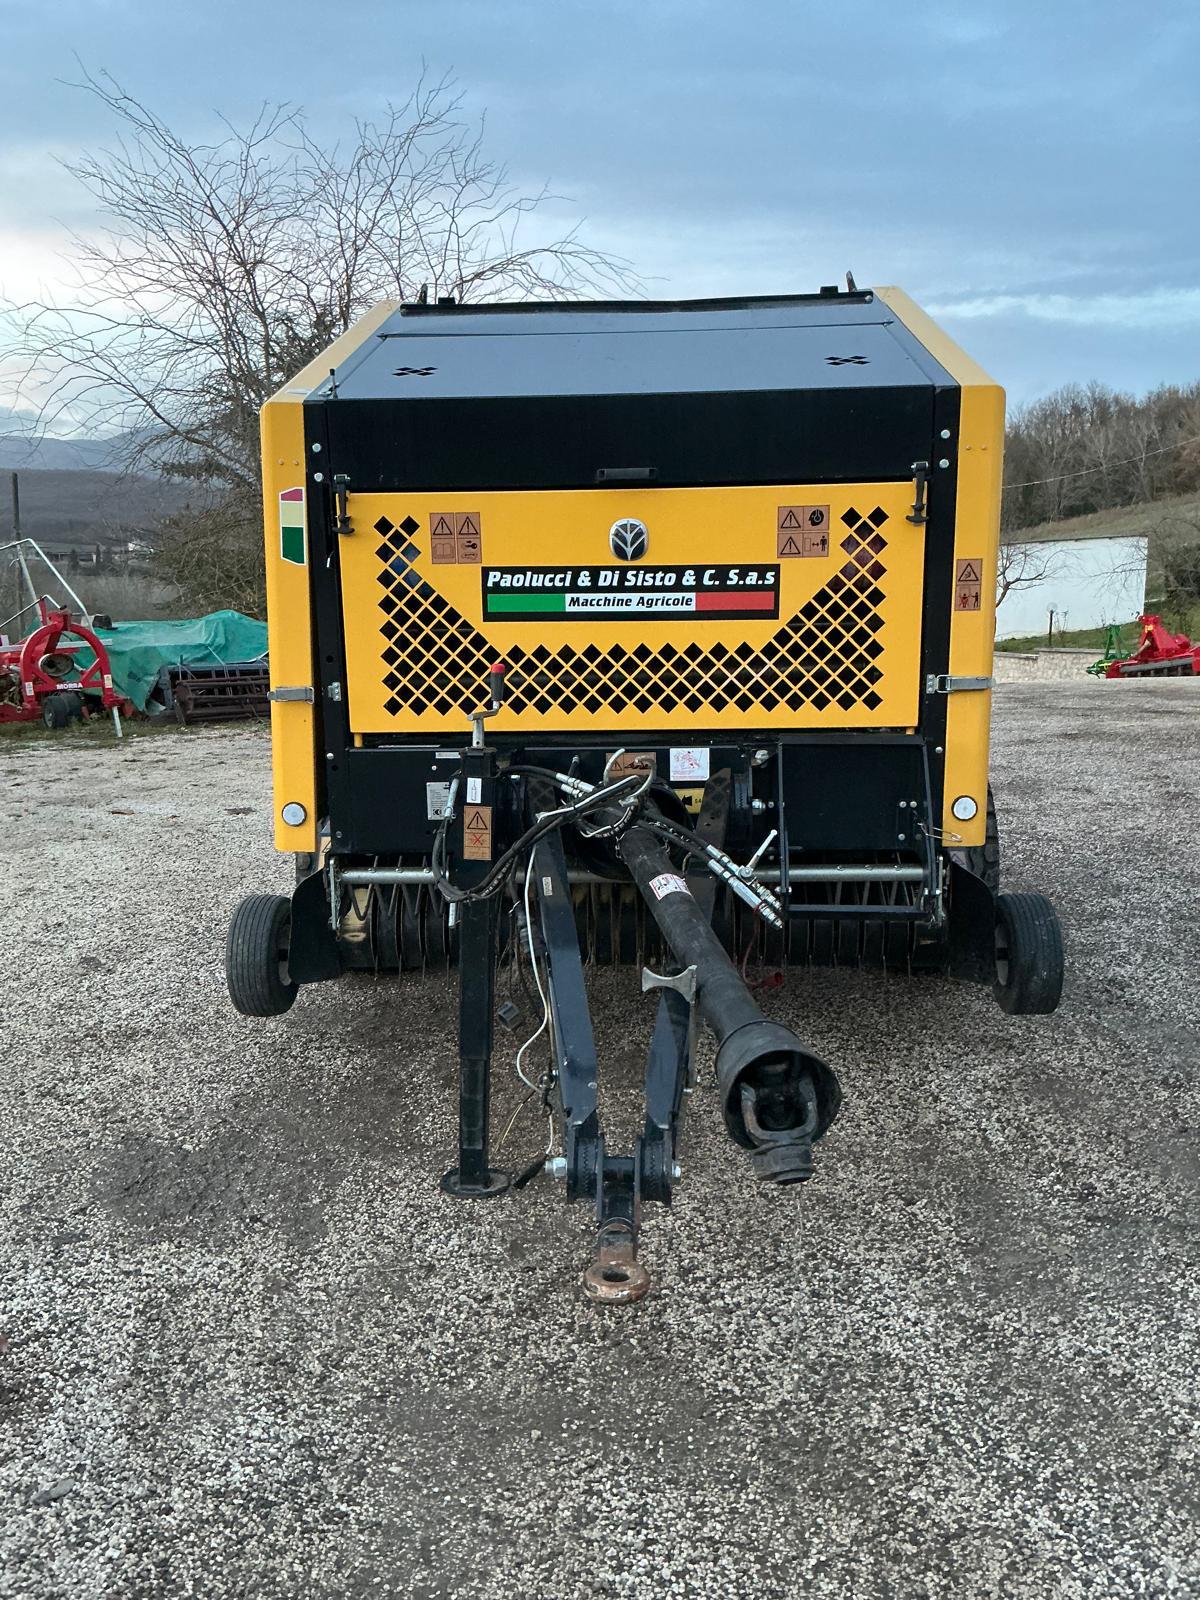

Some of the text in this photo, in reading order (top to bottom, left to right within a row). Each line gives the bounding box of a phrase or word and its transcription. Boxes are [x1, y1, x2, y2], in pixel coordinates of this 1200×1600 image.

[487, 569, 775, 587] Paolucci & Di Sisto & C. S.a.s
[568, 596, 693, 608] Macchine Agricole
